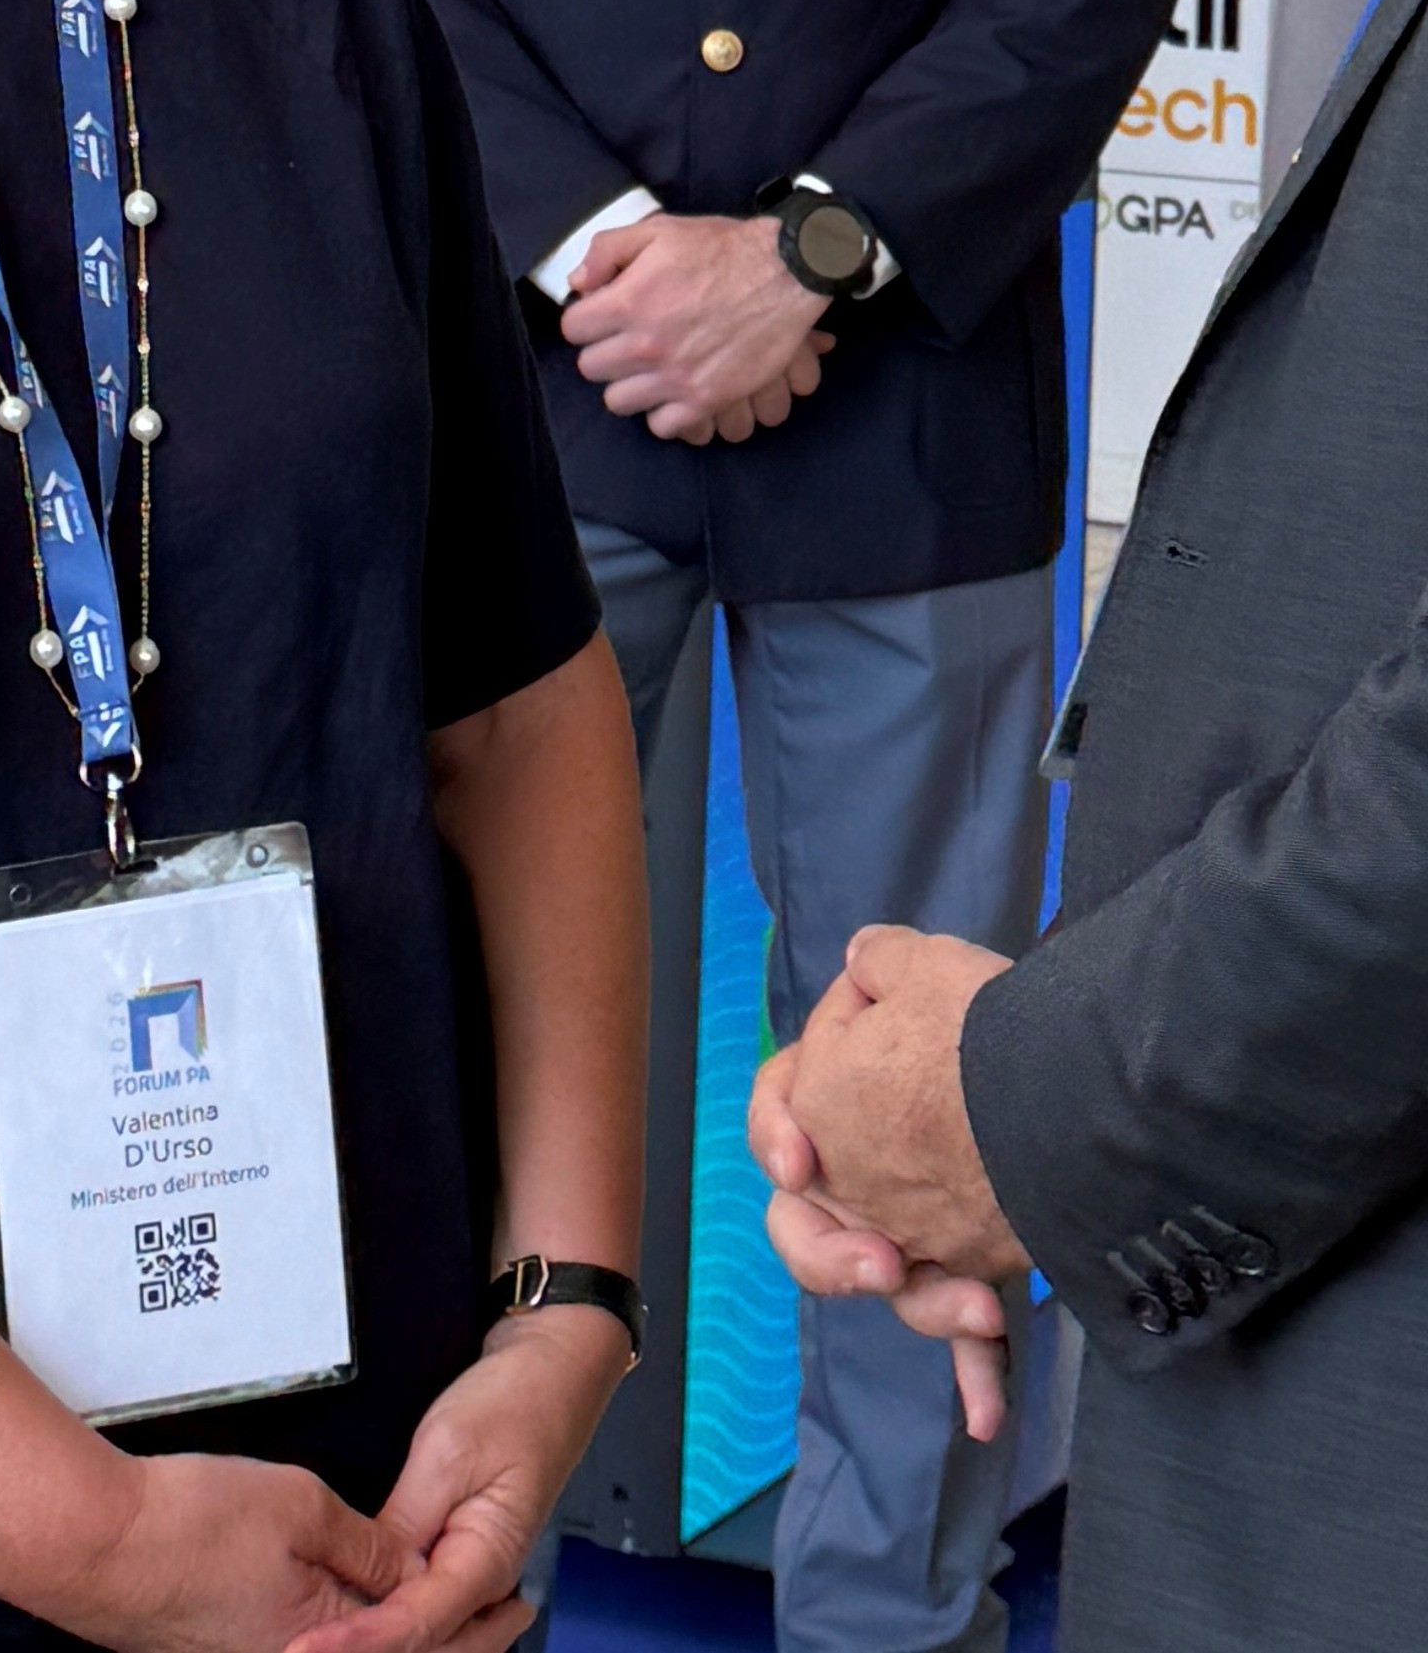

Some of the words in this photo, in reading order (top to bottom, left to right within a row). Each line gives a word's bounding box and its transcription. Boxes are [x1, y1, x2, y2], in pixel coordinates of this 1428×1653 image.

[113, 1070, 181, 1096] FORUM
[186, 1065, 210, 1084] PA
[111, 1105, 219, 1136] Valentina
[124, 1137, 213, 1168] D'Urso
[71, 1182, 157, 1210] Ministero
[163, 1164, 270, 1194] dell'Interno
